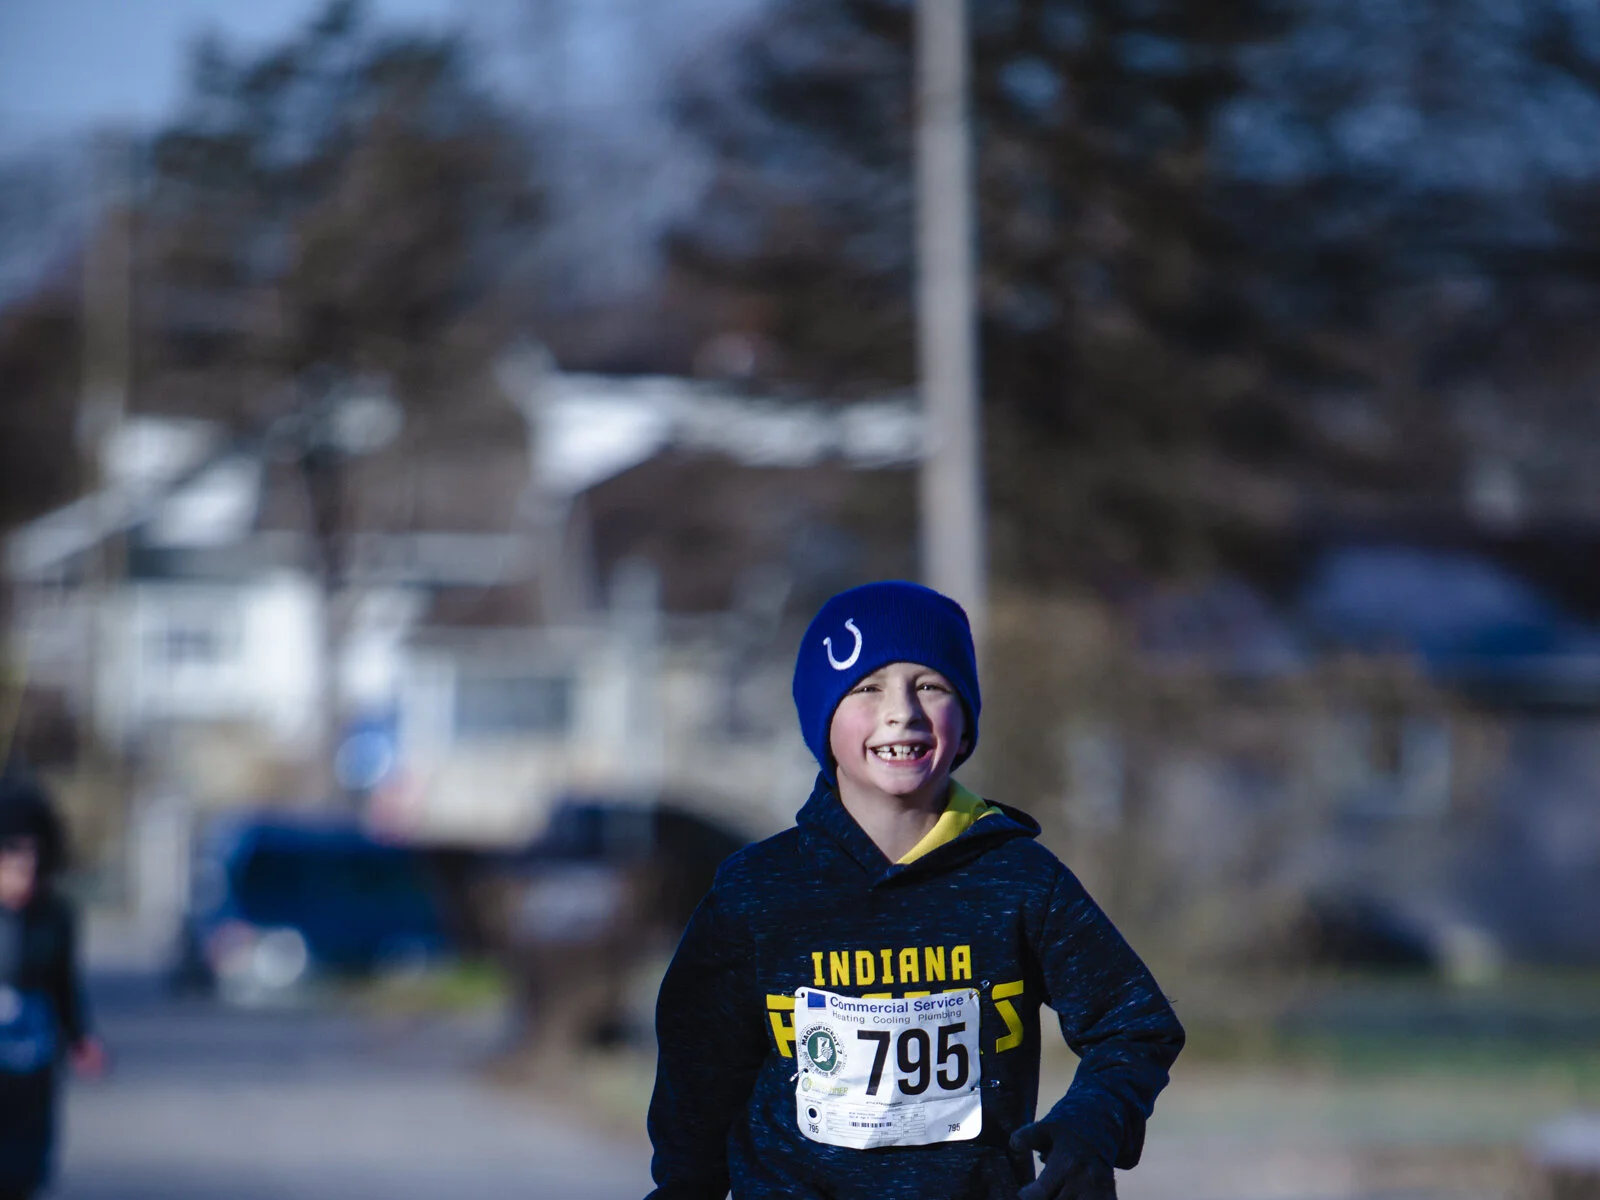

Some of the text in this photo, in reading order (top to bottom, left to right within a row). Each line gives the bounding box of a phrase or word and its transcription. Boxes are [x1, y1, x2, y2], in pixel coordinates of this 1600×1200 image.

[811, 945, 972, 987] INDIANA
[830, 996, 964, 1013] Commercial Service
[832, 1009, 962, 1025] Heating Cooling Plumbing
[857, 1022, 969, 1096] 795
[808, 1123, 819, 1134] 795
[947, 1122, 961, 1132] 795
